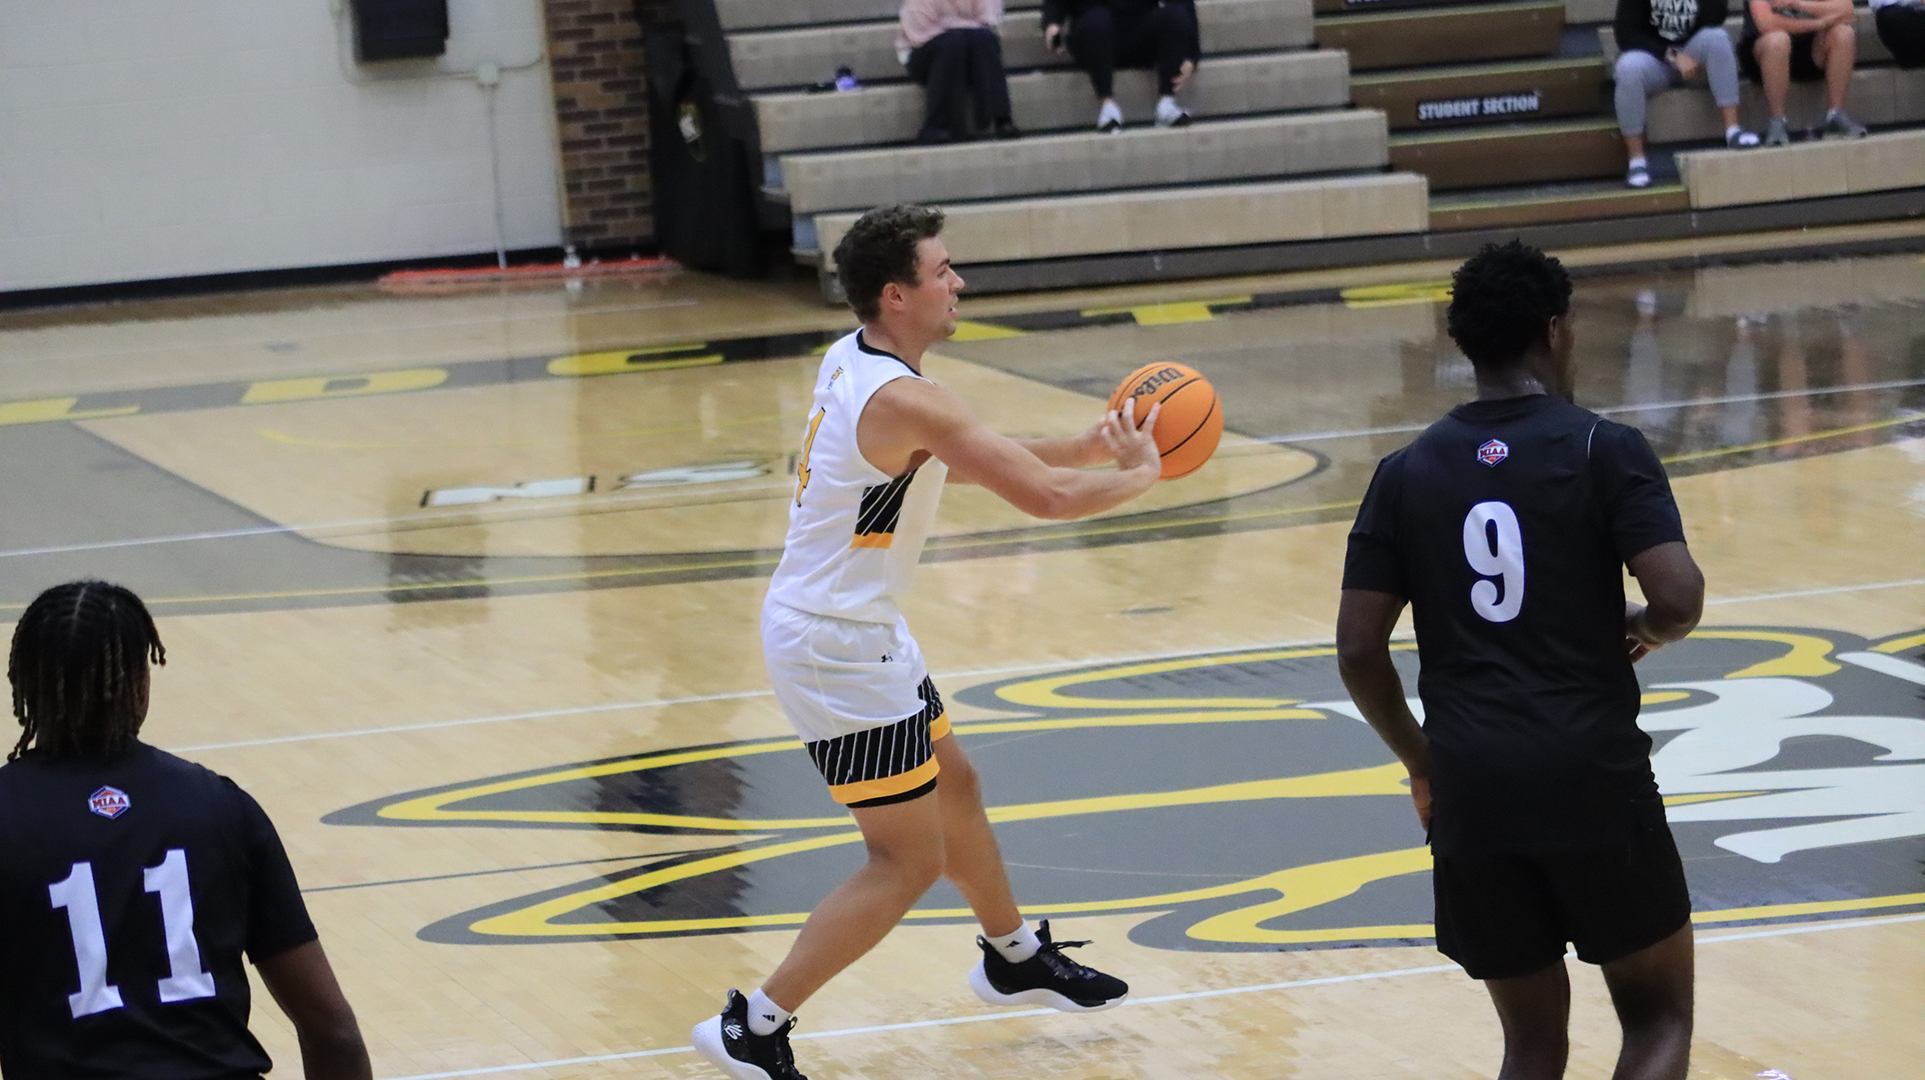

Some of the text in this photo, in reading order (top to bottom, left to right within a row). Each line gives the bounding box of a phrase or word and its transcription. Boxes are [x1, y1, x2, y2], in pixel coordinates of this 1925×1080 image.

[1418, 93, 1540, 120] STUDENT SECTION
[1480, 447, 1506, 458] MIAA
[1463, 501, 1525, 622] 9
[92, 796, 127, 809] MIAA
[49, 849, 216, 1019] 11
